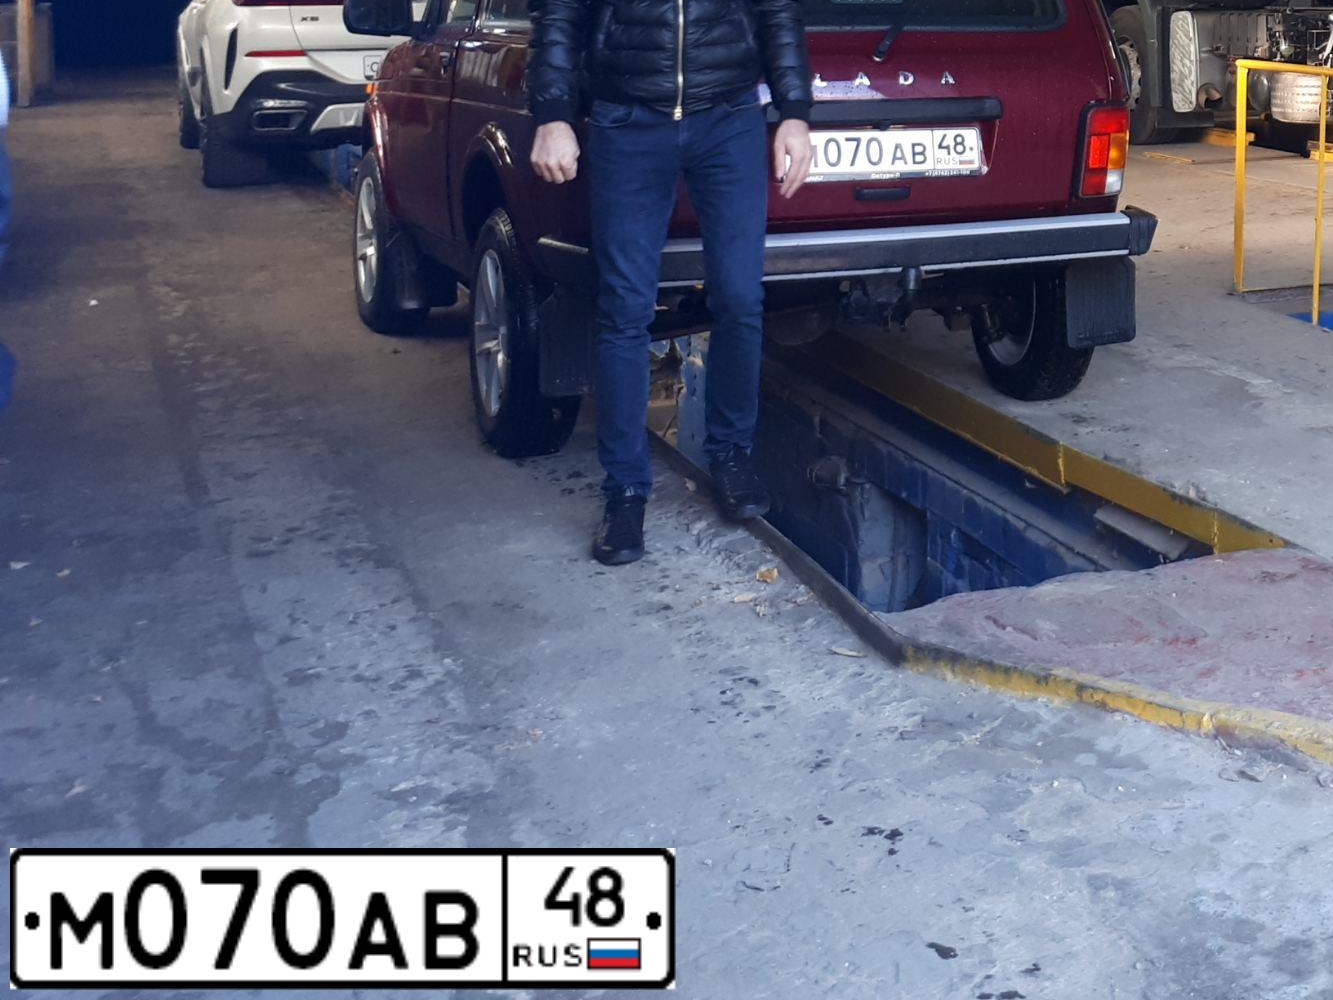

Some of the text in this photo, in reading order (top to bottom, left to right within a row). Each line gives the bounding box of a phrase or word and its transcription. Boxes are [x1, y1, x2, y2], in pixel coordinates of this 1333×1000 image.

[813, 71, 956, 88] LADA
[937, 133, 967, 156] 48
[936, 156, 958, 166] RUS
